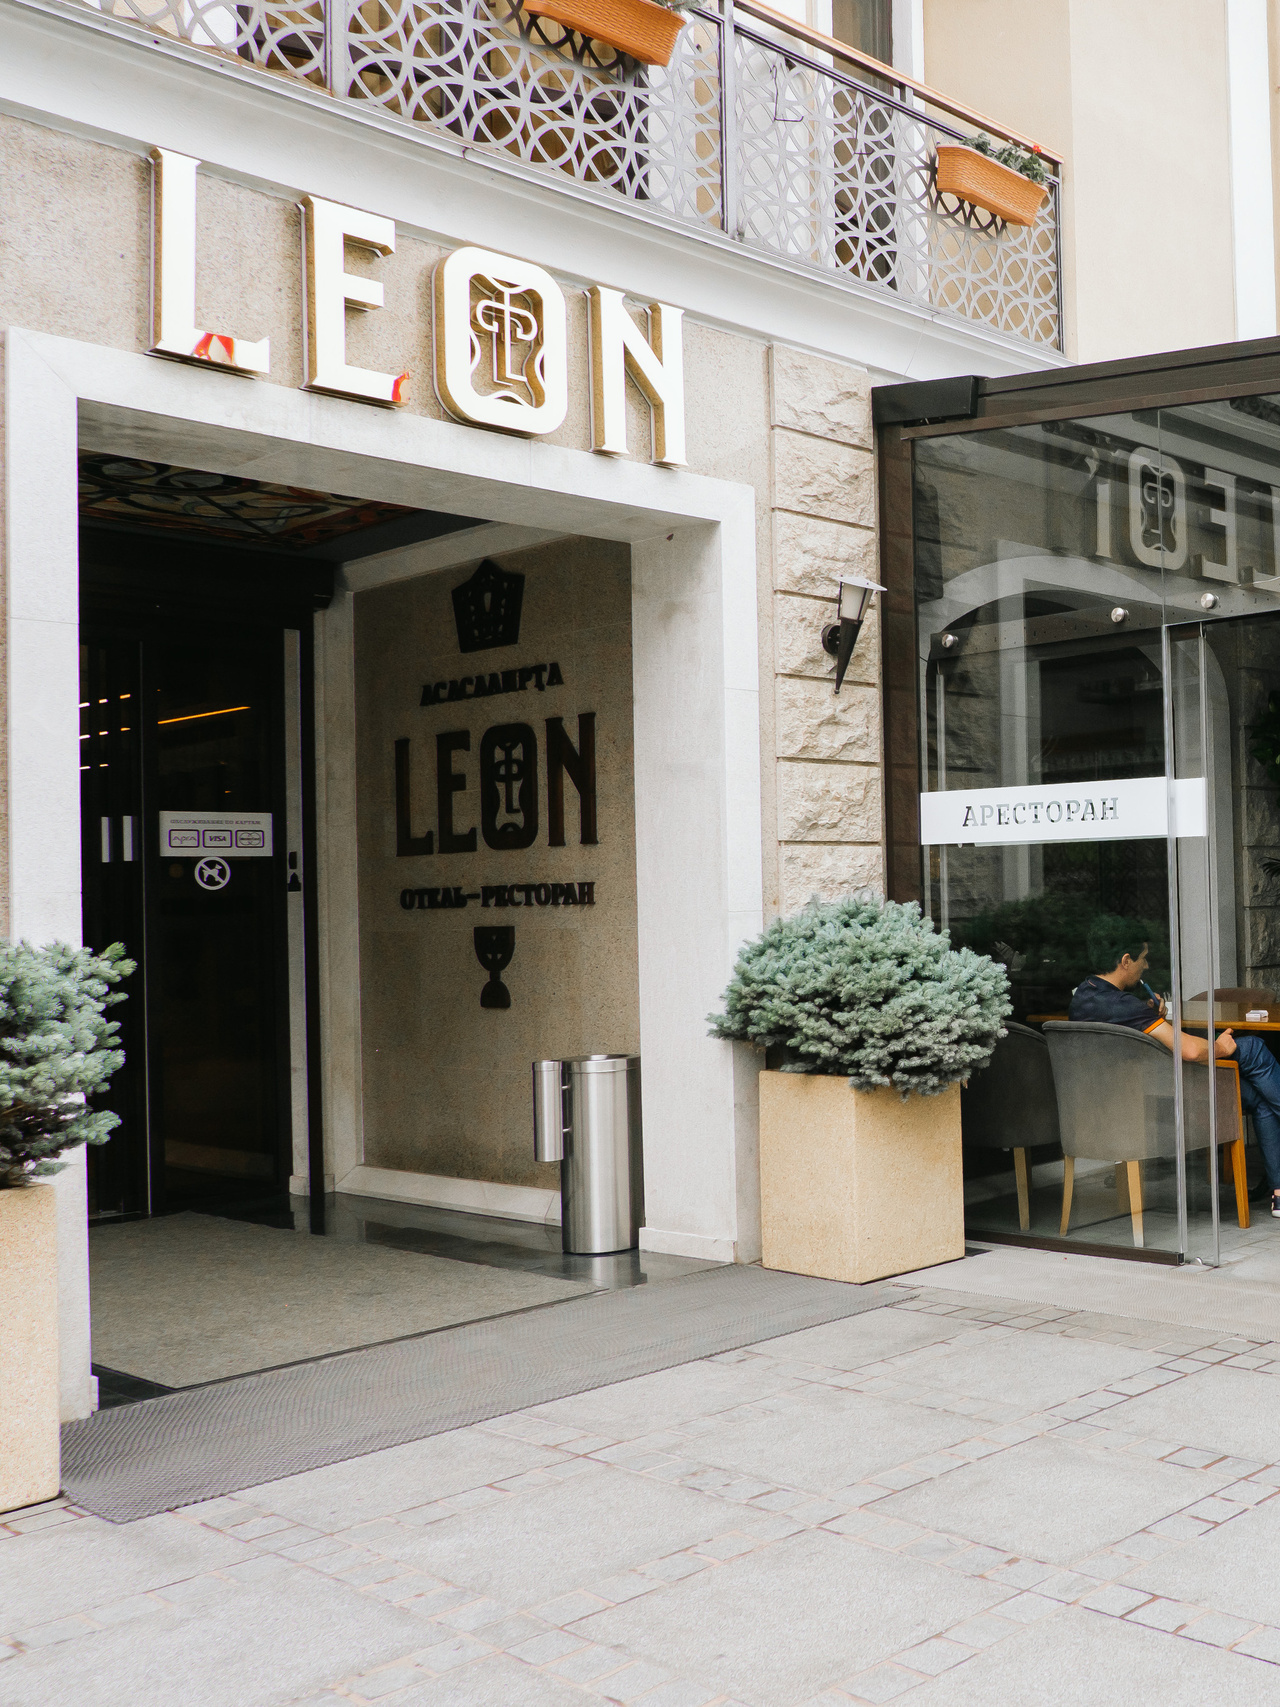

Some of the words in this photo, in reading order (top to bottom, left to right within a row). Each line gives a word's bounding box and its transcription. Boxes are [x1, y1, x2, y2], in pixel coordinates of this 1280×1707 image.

[146, 146, 688, 469] LEON
[394, 711, 599, 857] LEON
[962, 797, 1119, 827] АРЕСТОРАН
